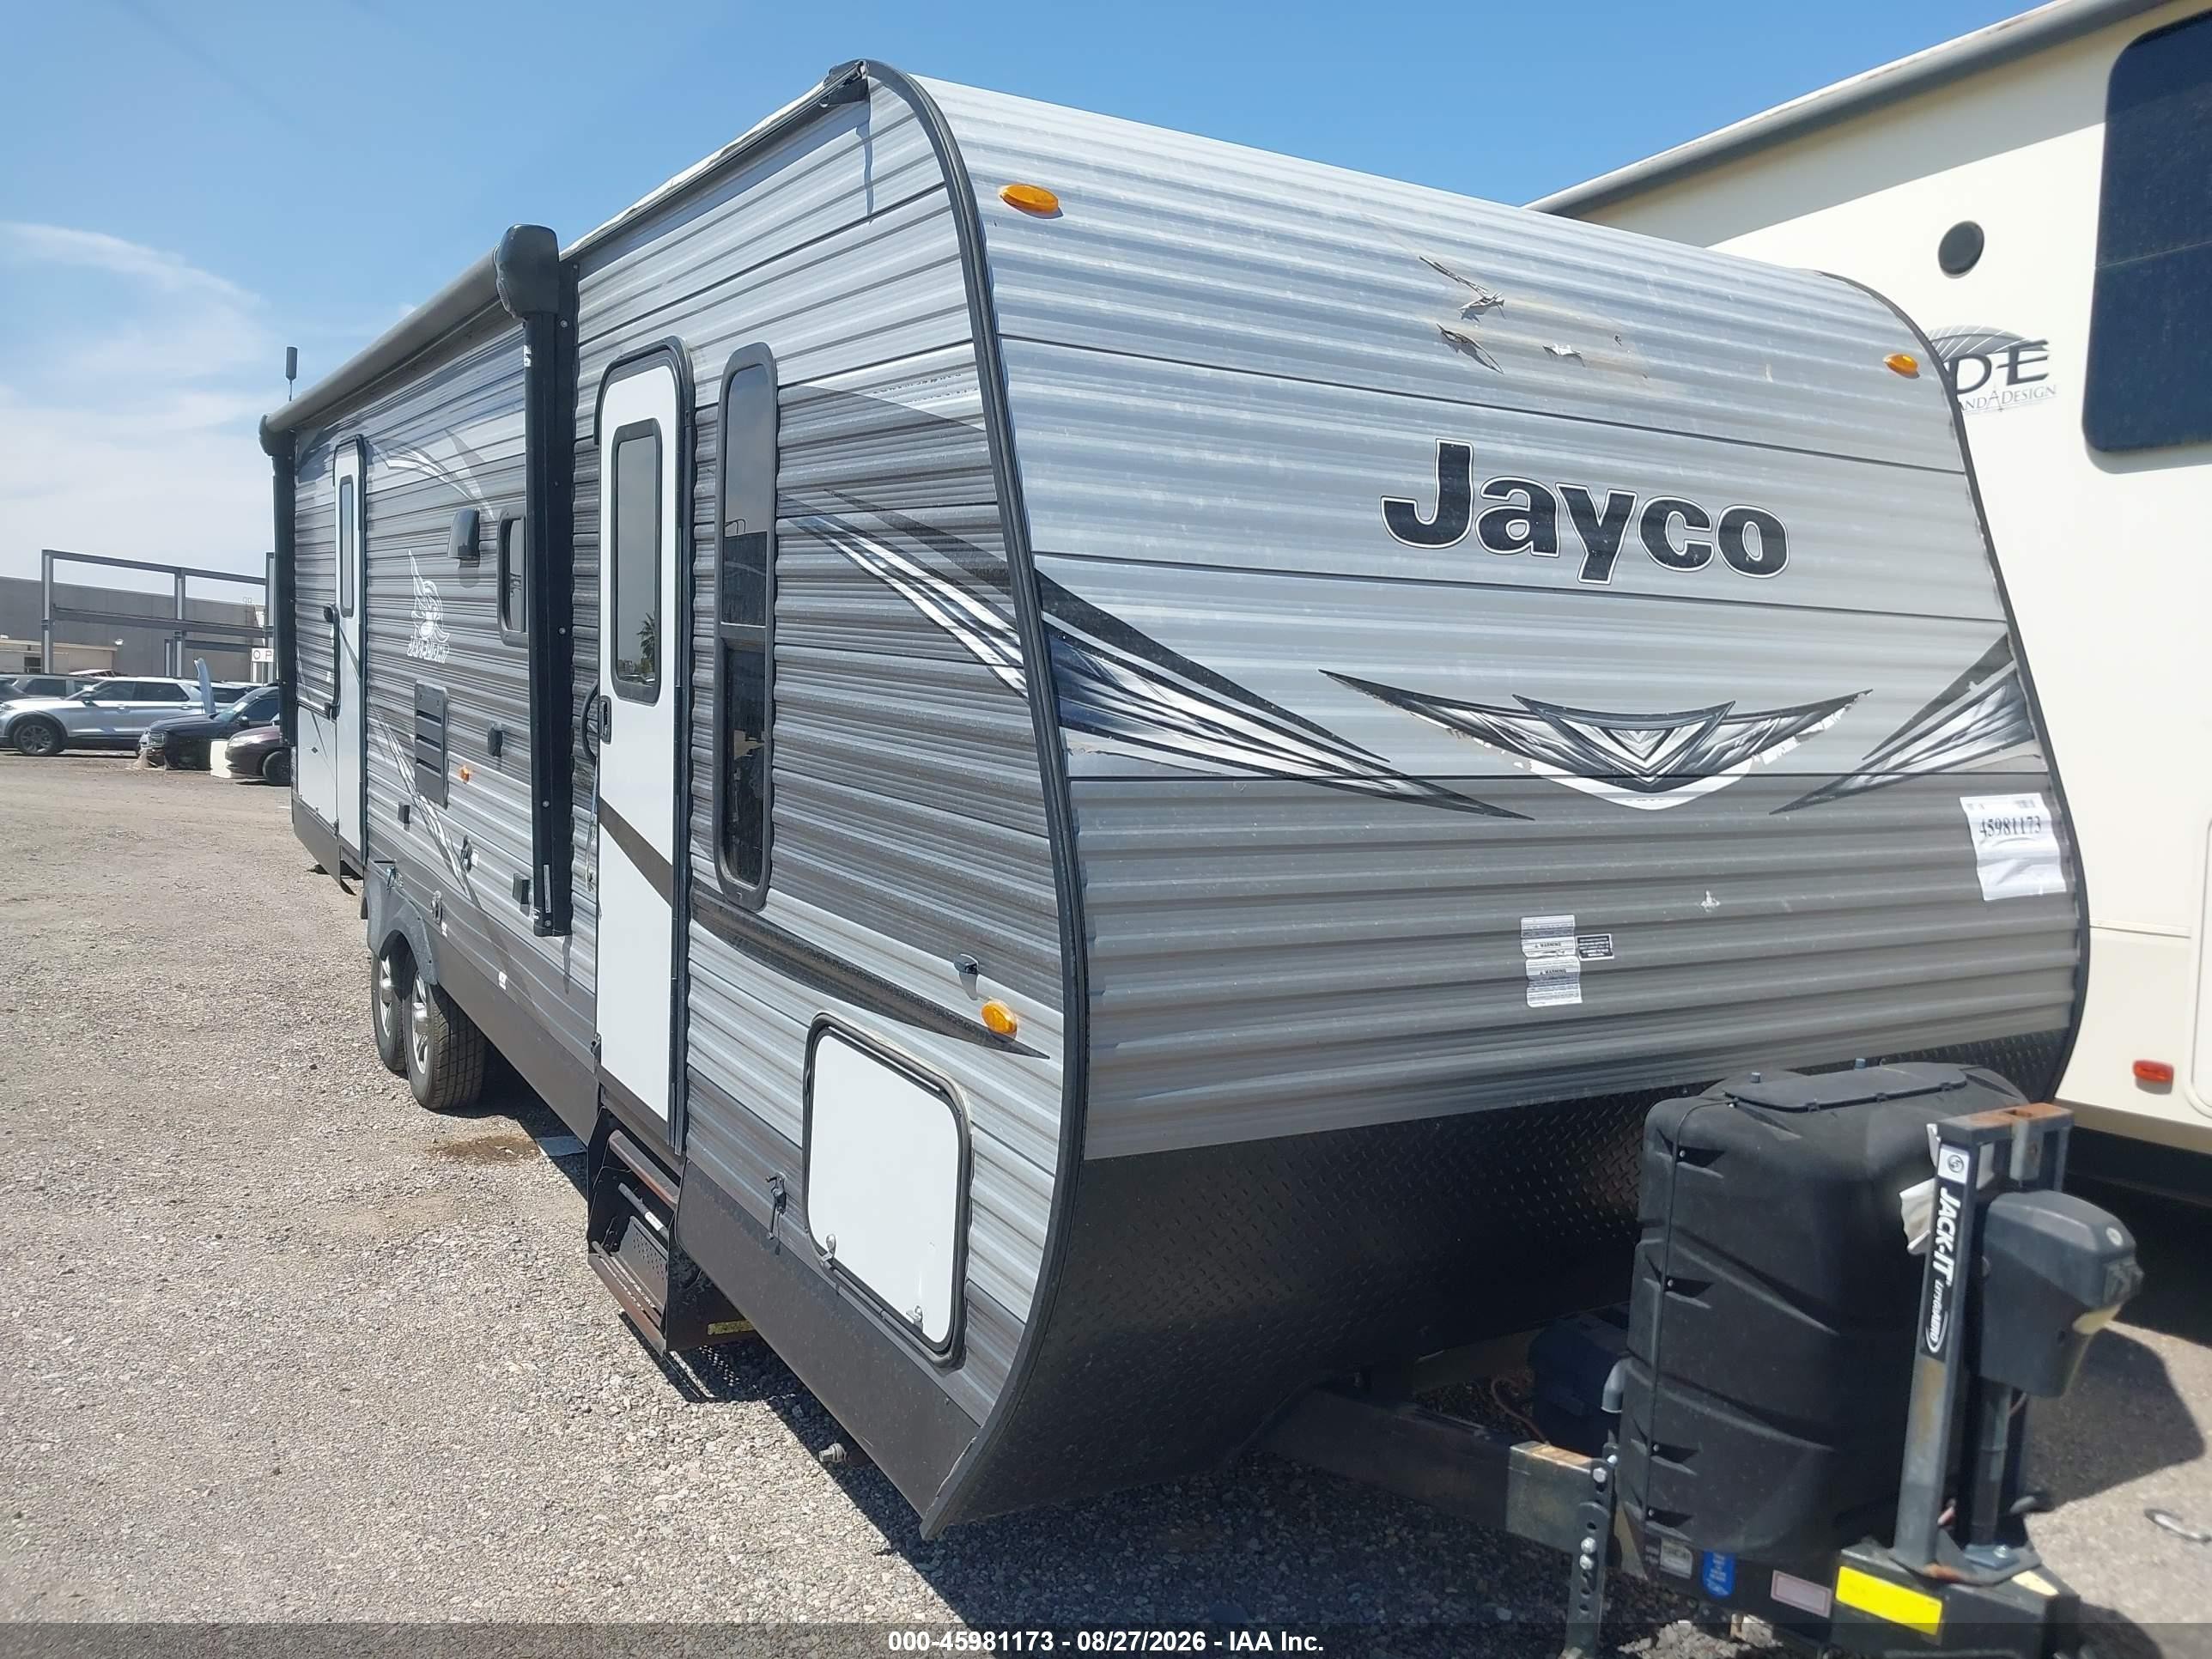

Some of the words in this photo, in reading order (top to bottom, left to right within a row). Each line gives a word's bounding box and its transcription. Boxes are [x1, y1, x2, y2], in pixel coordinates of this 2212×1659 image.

[1379, 437, 1790, 586] Jayco
[1979, 815, 2042, 838] 45981173
[1931, 1187, 1962, 1286] JACK-IT
